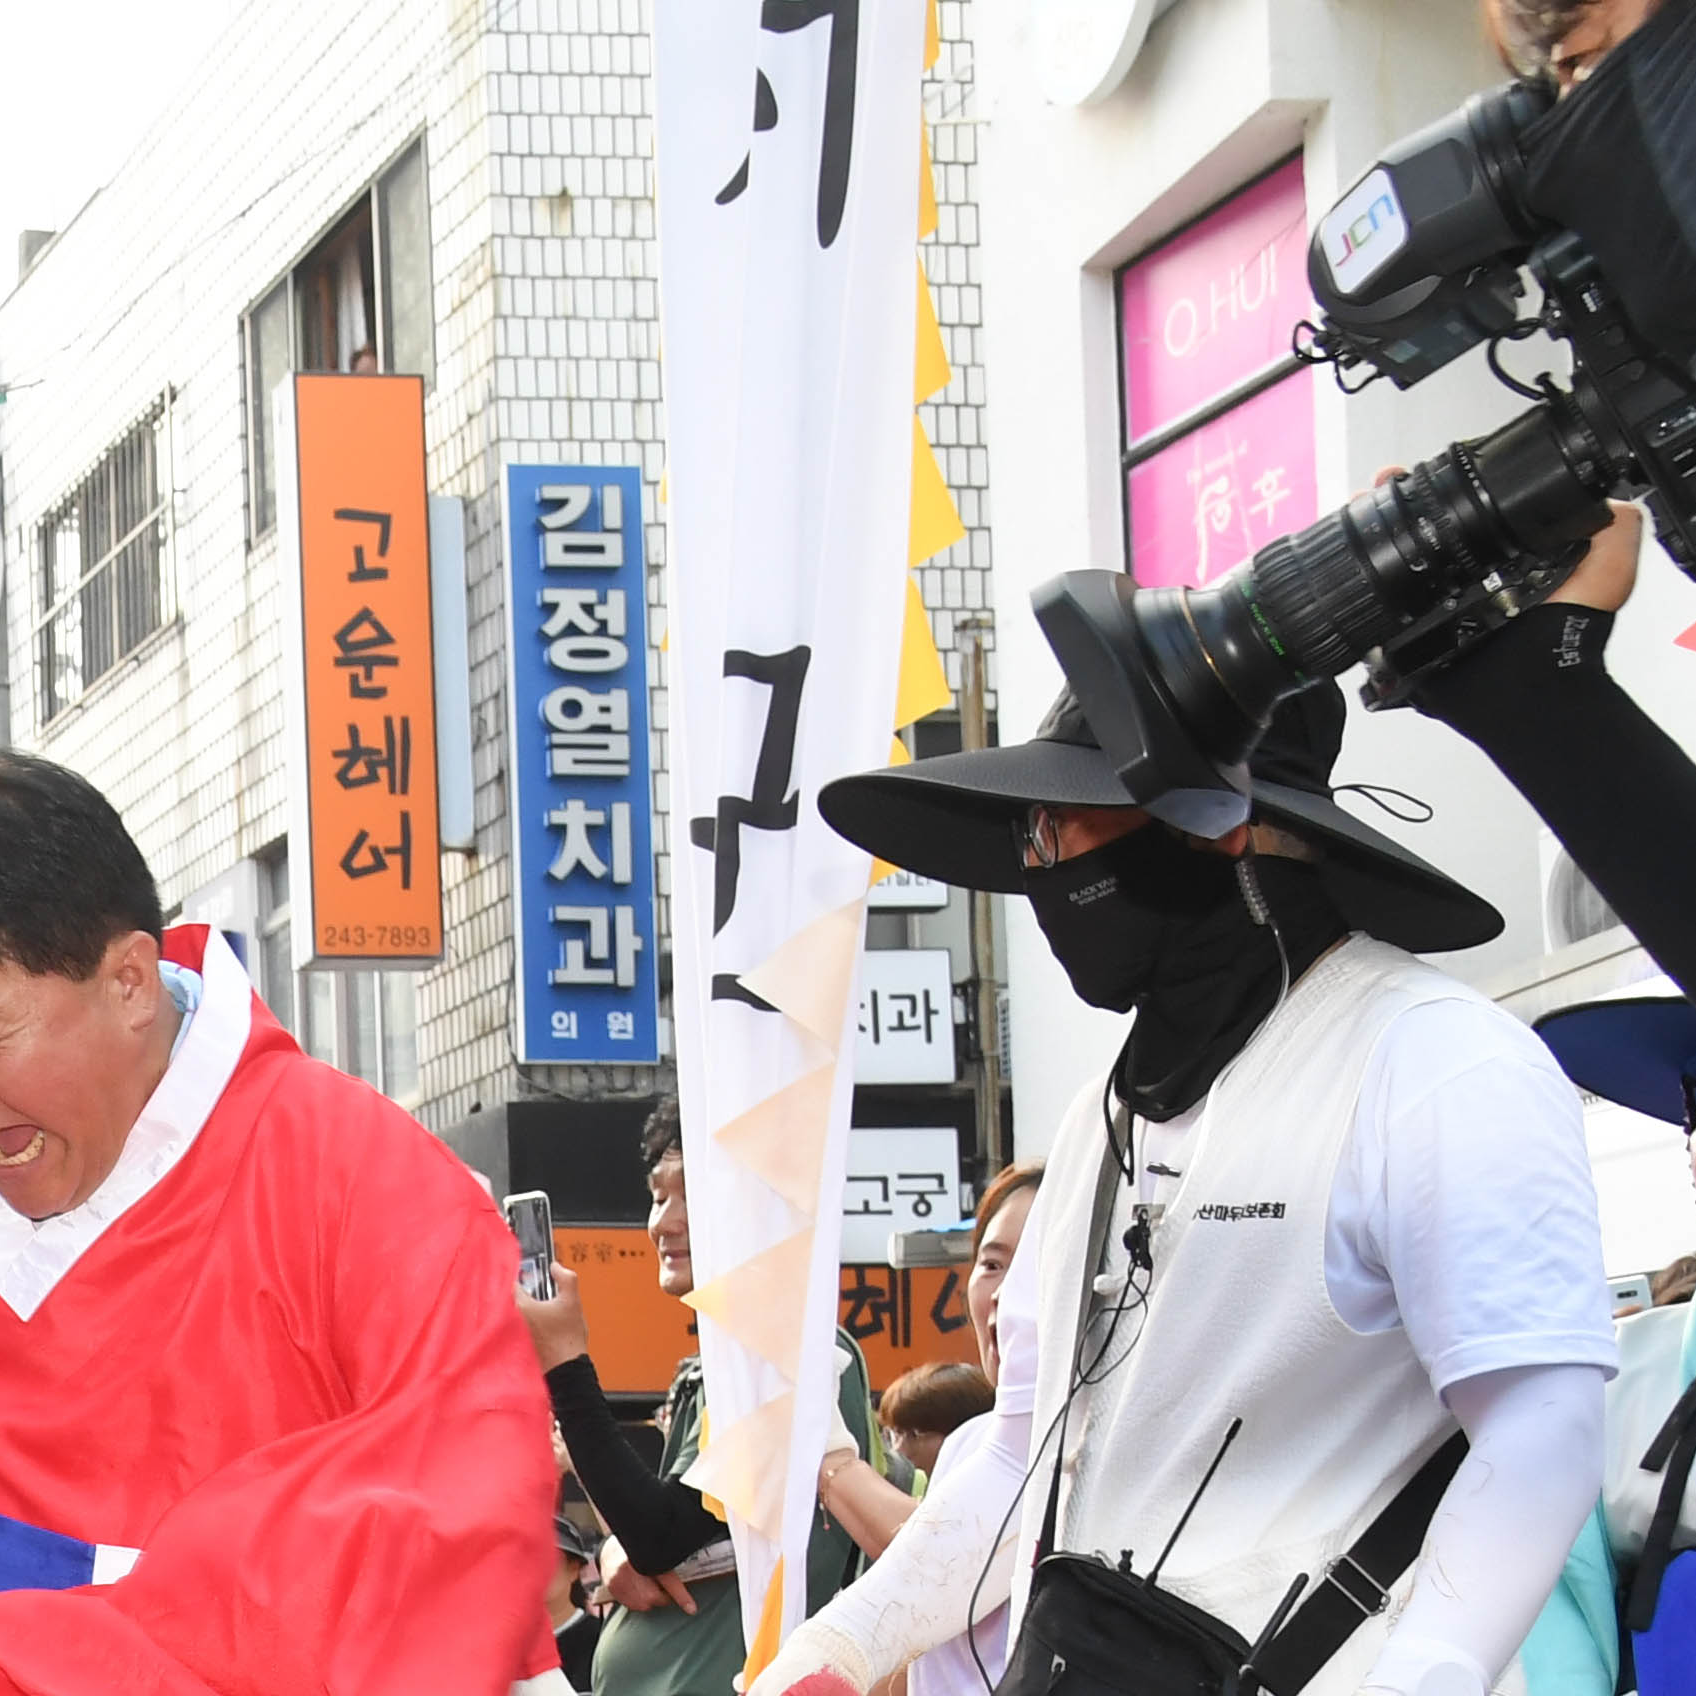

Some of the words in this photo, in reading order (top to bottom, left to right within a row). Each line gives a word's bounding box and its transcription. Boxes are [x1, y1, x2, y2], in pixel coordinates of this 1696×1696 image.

[535, 484, 643, 989] 김정열치과
[323, 925, 432, 949] 243-7893
[843, 1172, 948, 1218] 고궁
